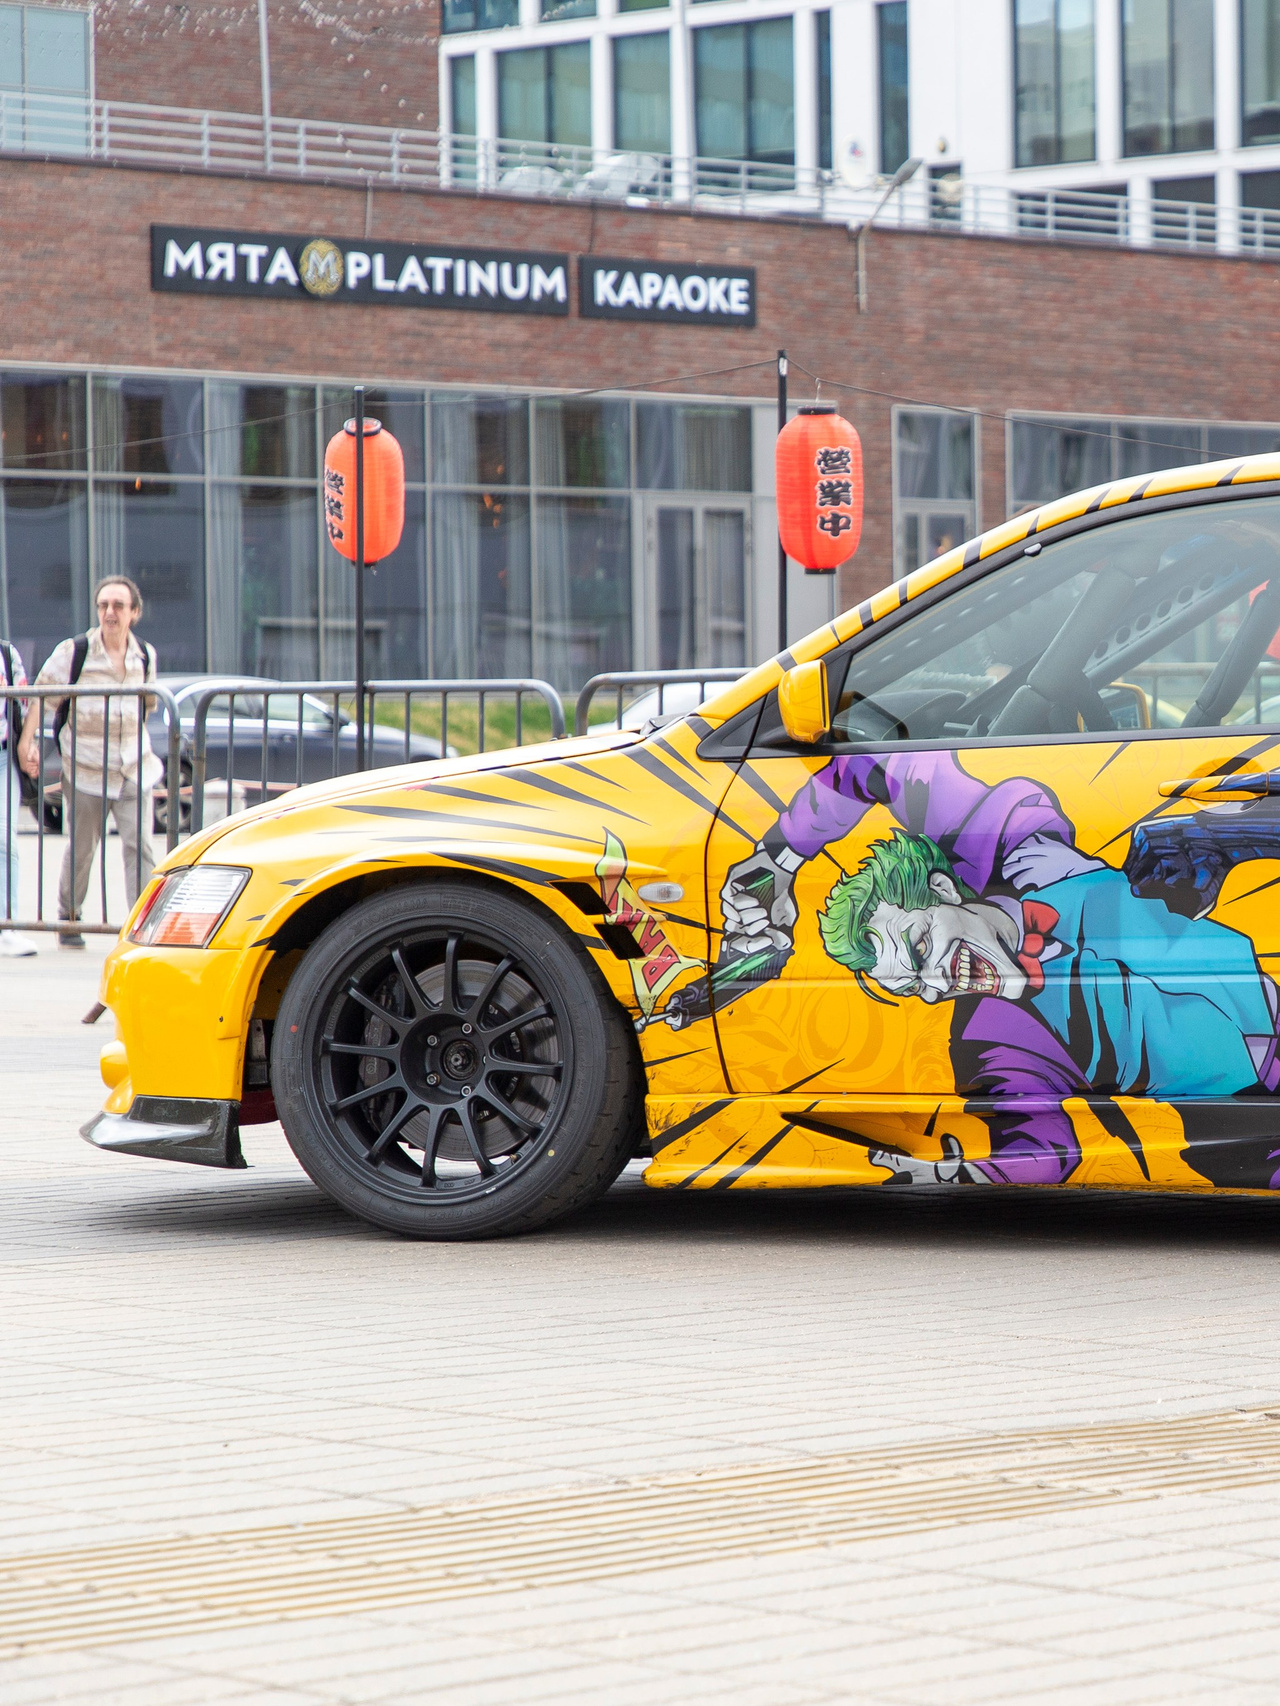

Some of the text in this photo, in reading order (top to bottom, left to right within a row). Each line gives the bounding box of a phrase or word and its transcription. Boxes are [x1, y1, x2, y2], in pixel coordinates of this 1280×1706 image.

[163, 239, 299, 286] МЯТА
[345, 251, 567, 303] PLATINUM
[594, 269, 750, 314] КАРАОКЕ
